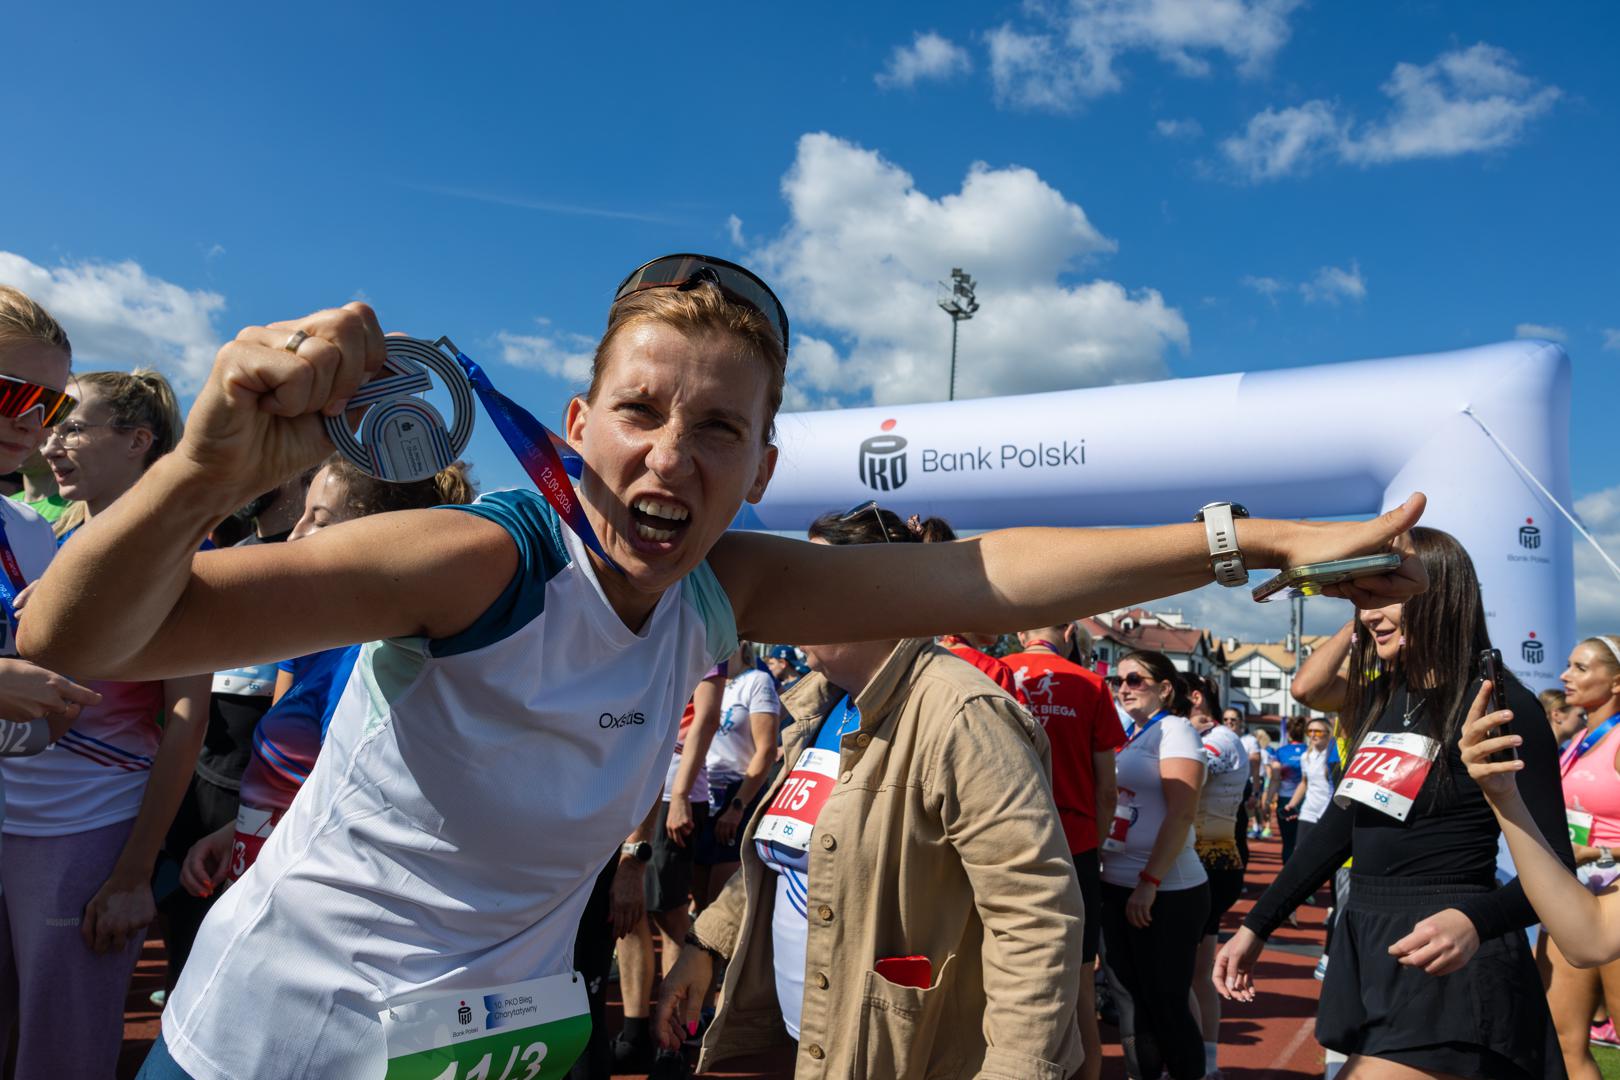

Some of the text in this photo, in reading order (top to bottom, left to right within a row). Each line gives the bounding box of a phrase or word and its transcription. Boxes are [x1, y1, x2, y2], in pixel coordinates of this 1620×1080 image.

[922, 439, 1086, 473] Bank Polski
[1041, 704, 1077, 717] BIEGA
[494, 995, 533, 1009] 10. PKO Bieg
[494, 1004, 538, 1020] Charytatywny
[452, 1027, 479, 1038] Bank Polski
